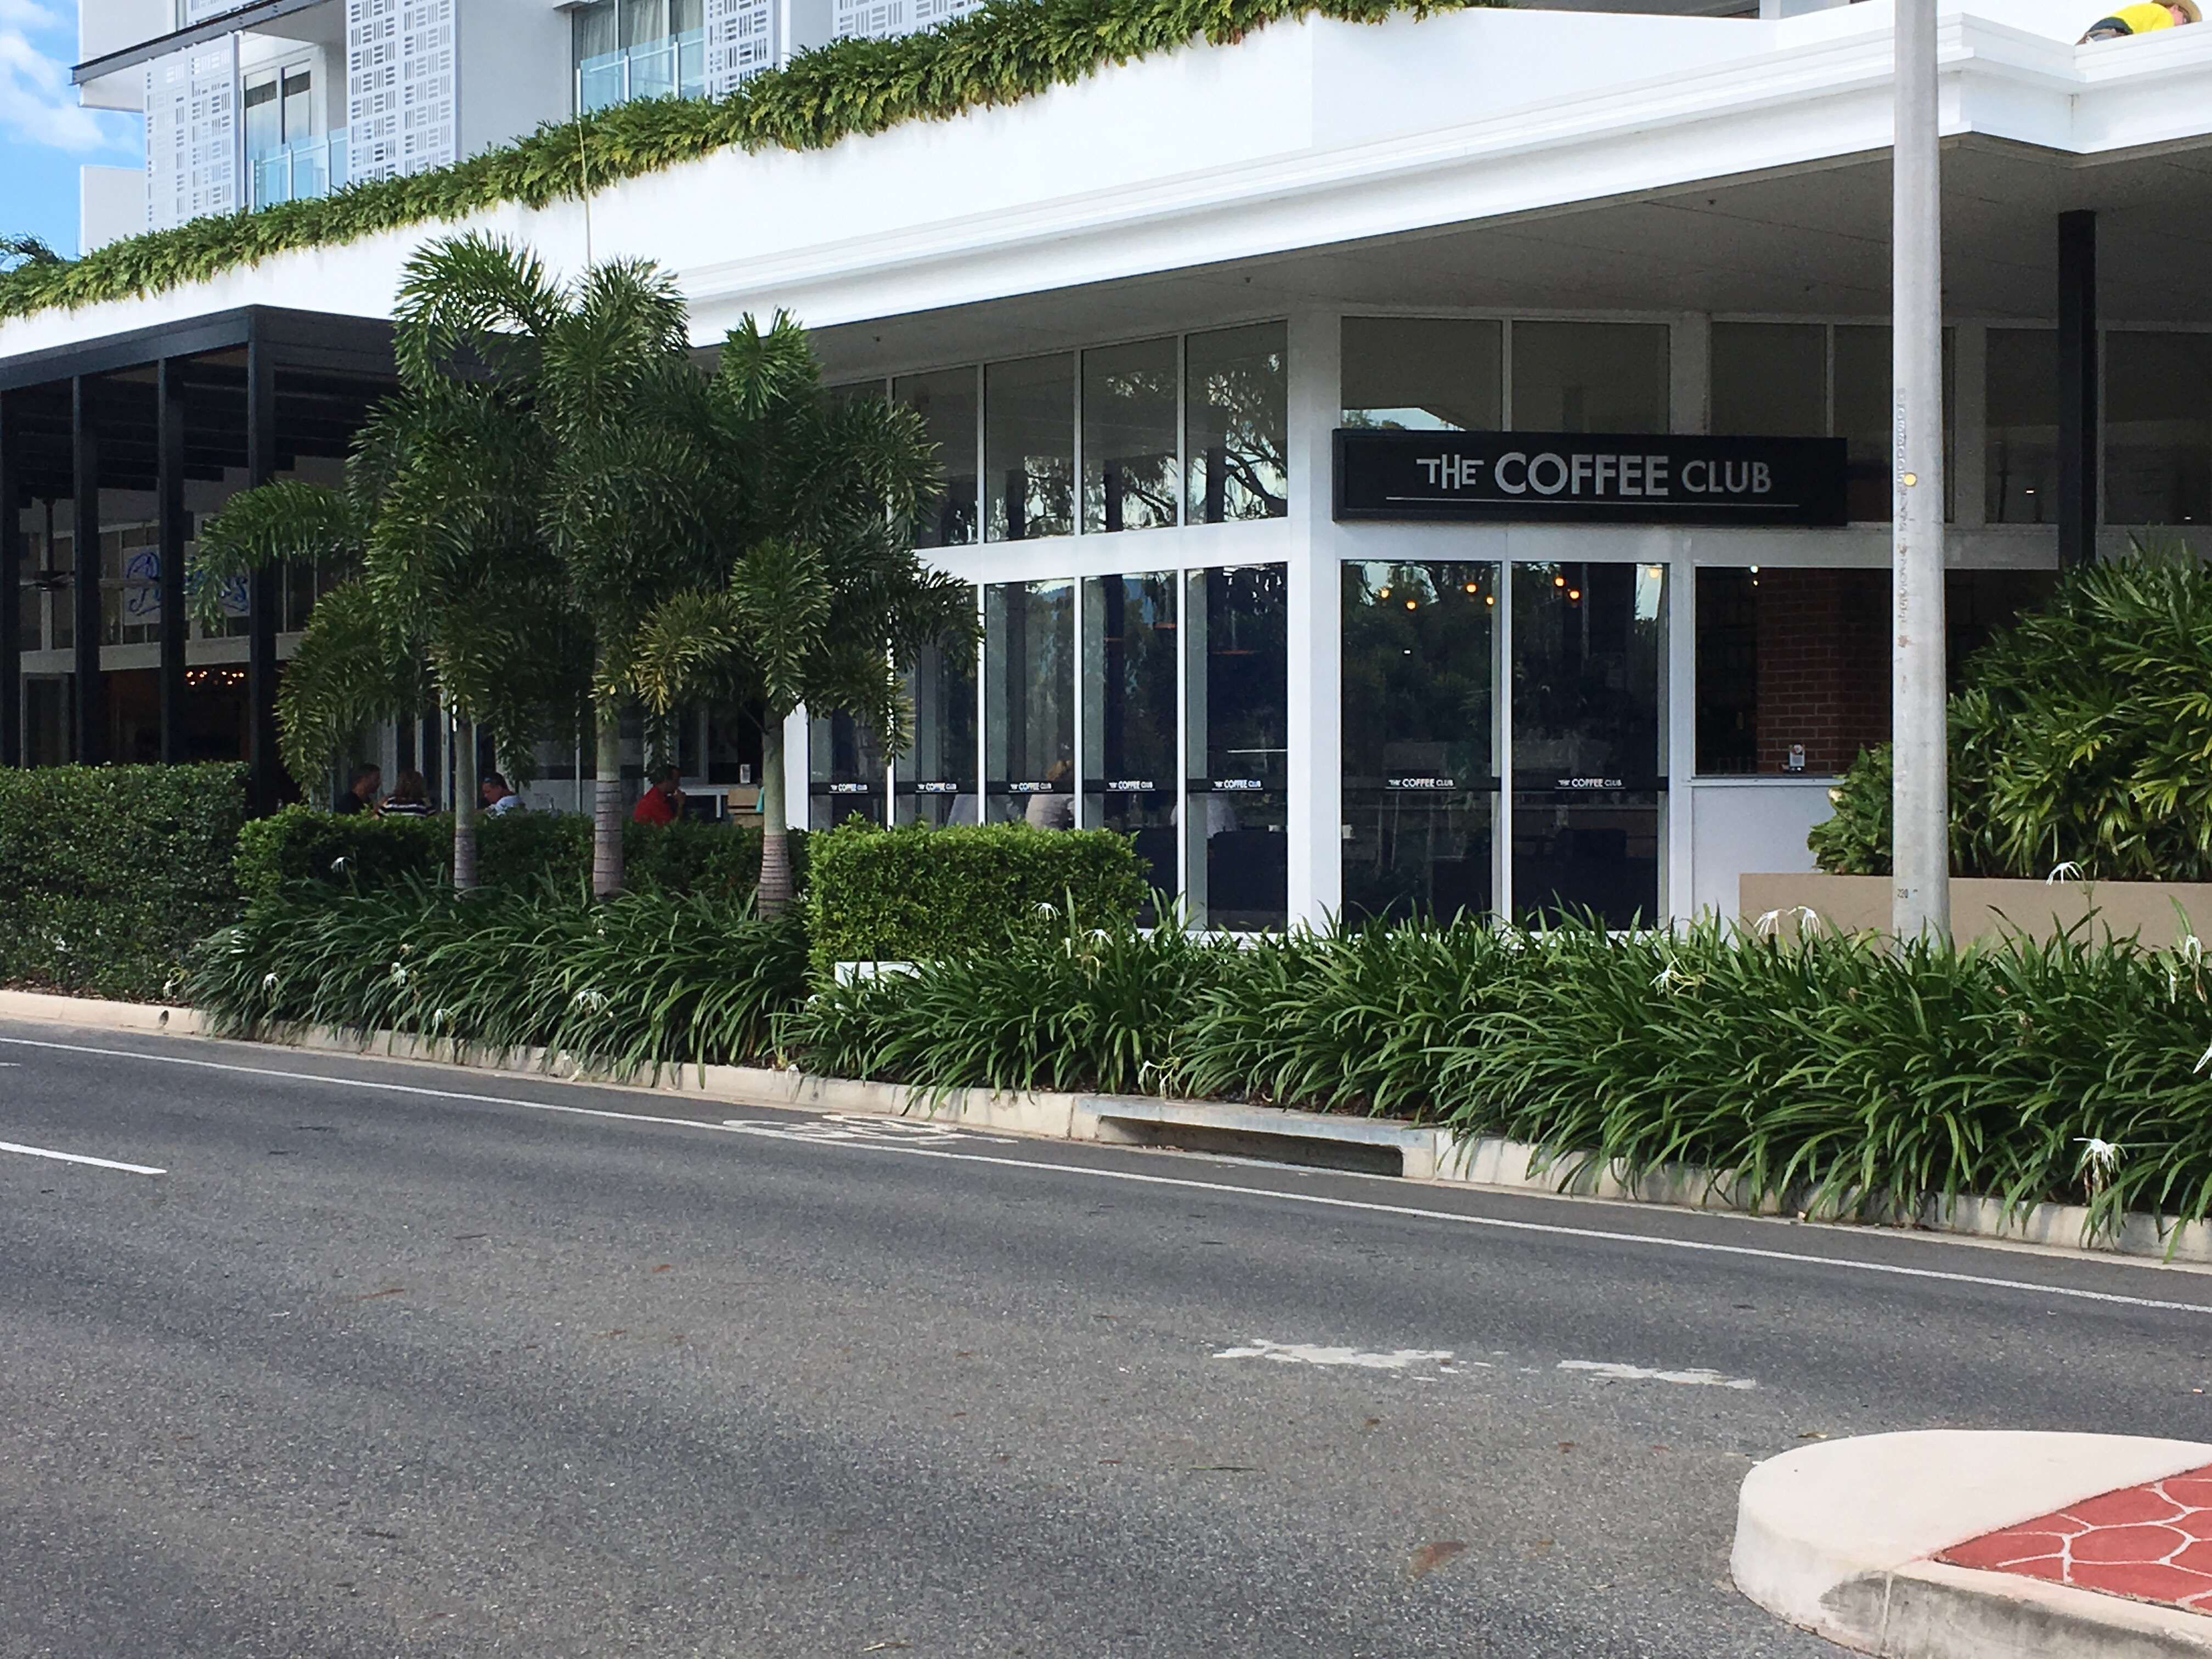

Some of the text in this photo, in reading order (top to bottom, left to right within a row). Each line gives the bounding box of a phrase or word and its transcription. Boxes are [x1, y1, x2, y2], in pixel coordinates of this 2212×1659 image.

[1416, 452, 1771, 495] THE COFFEE CLUB
[1402, 778, 1435, 787] COFFEE
[1572, 778, 1603, 787] COFFEE
